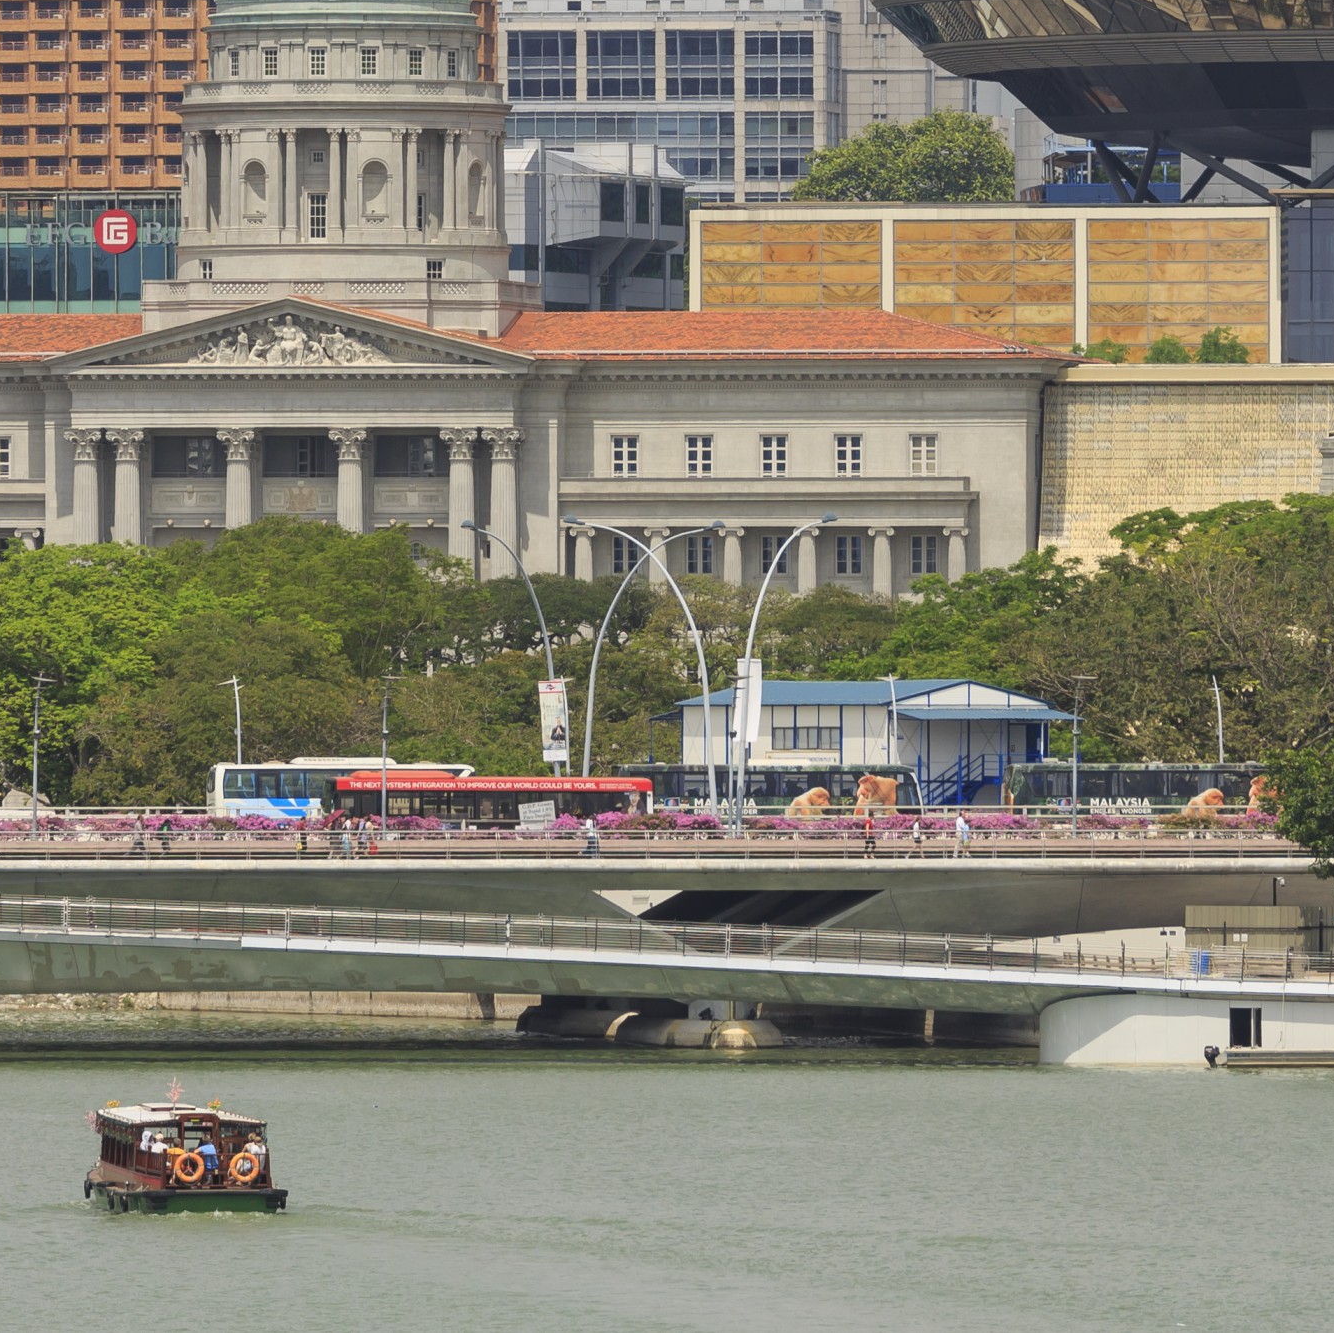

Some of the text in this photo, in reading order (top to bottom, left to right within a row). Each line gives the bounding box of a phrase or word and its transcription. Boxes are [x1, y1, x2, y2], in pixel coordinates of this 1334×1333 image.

[24, 222, 179, 246] EFG Ba
[1090, 798, 1150, 807] MALAYSIA
